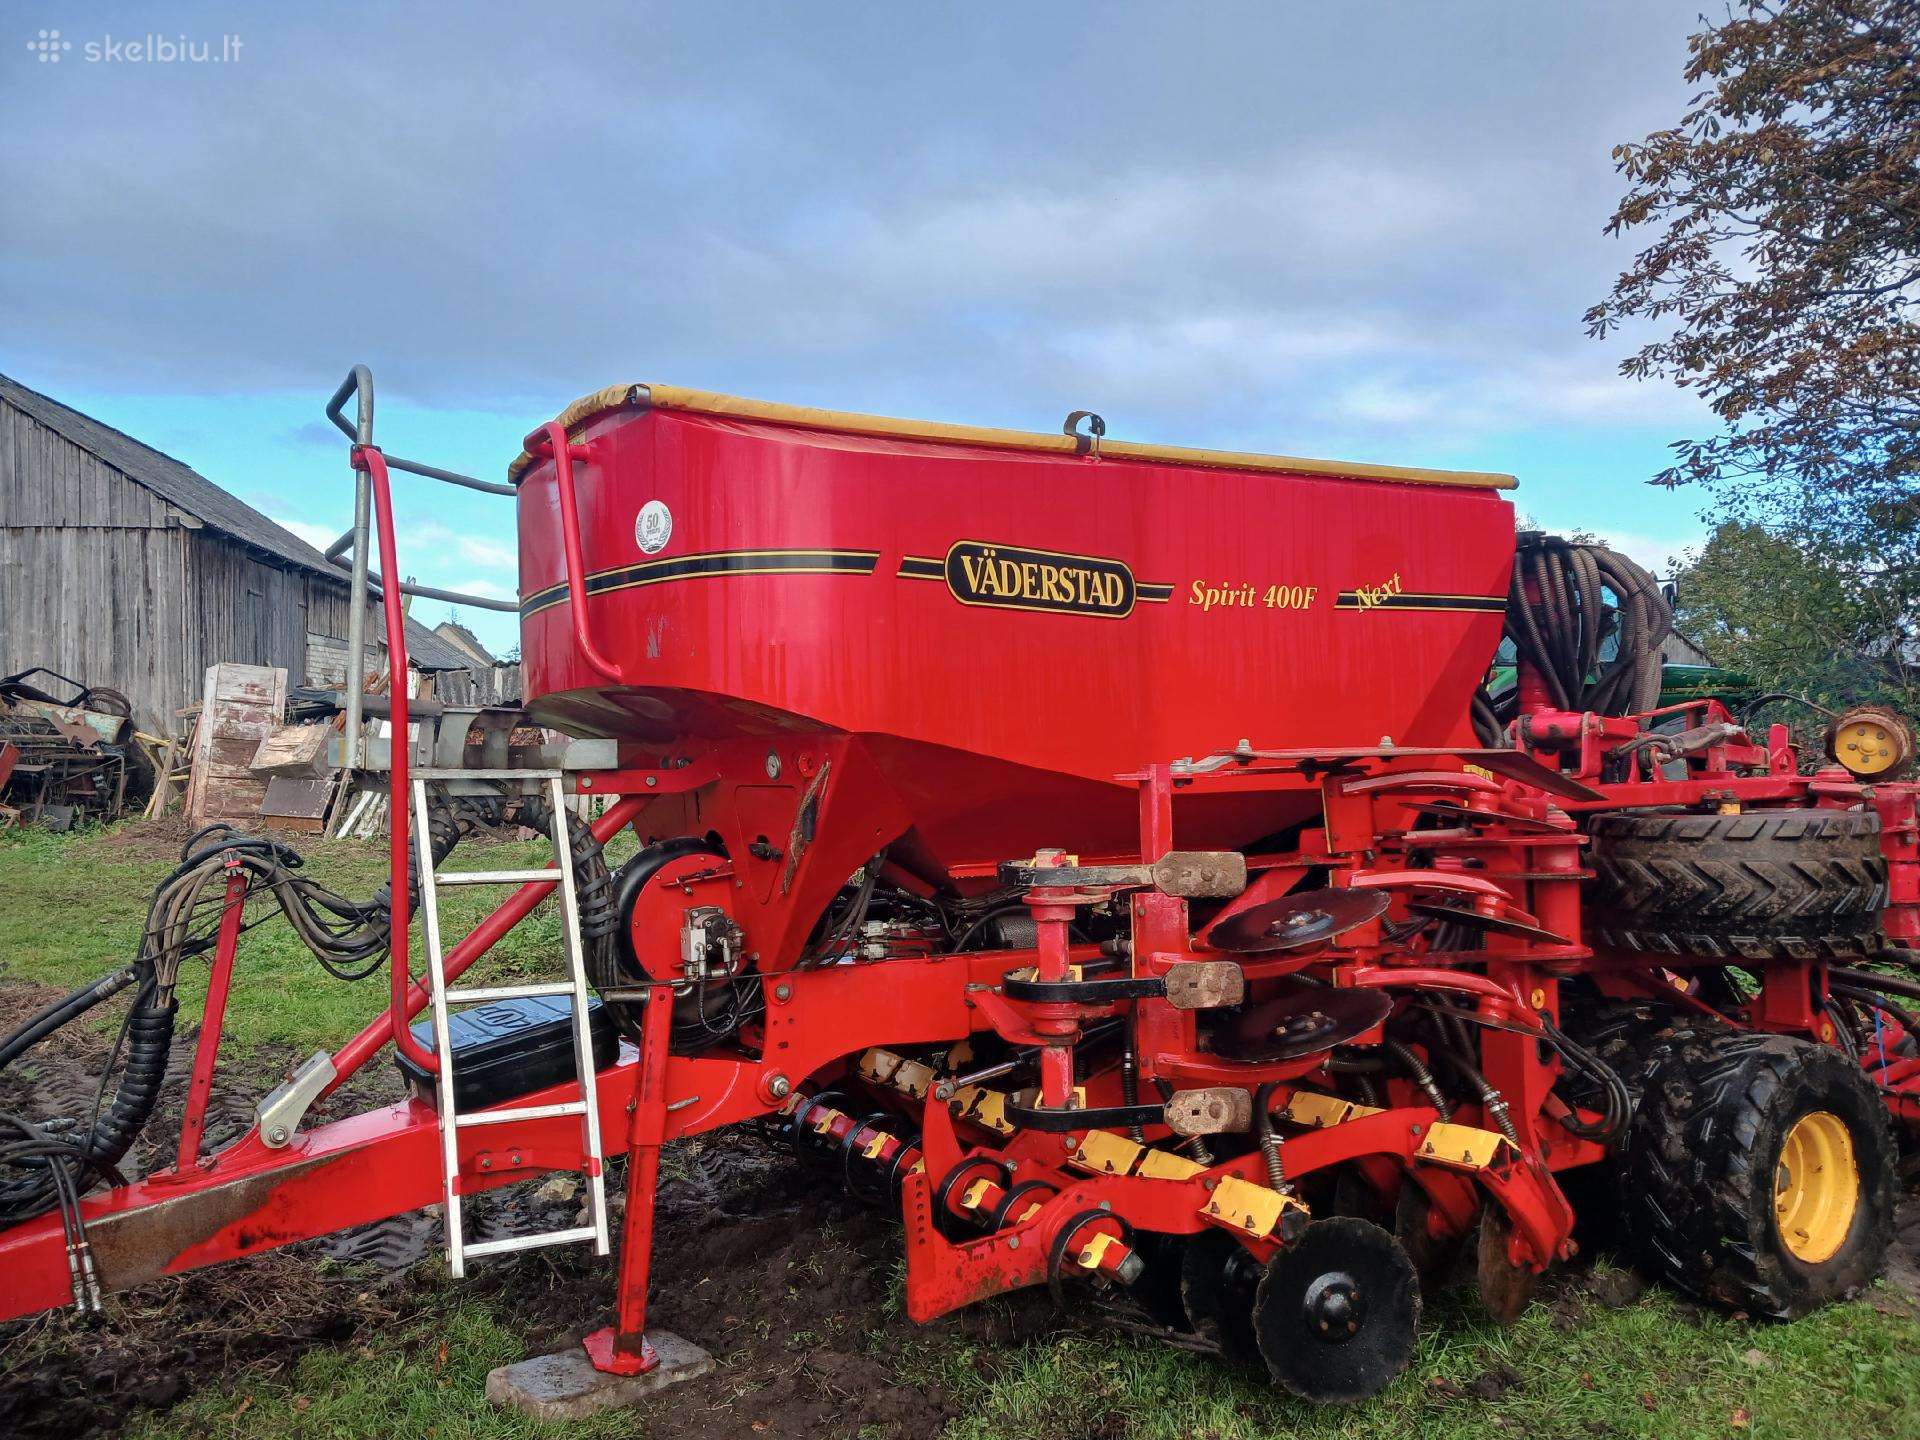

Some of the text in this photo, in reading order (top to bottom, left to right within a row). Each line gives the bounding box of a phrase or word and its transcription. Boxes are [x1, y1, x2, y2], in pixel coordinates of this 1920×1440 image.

[646, 512, 659, 529] 50
[960, 548, 1125, 607] VÄDERSTAD
[1189, 580, 1318, 612] Spirit 400F
[1355, 572, 1403, 614] Next
